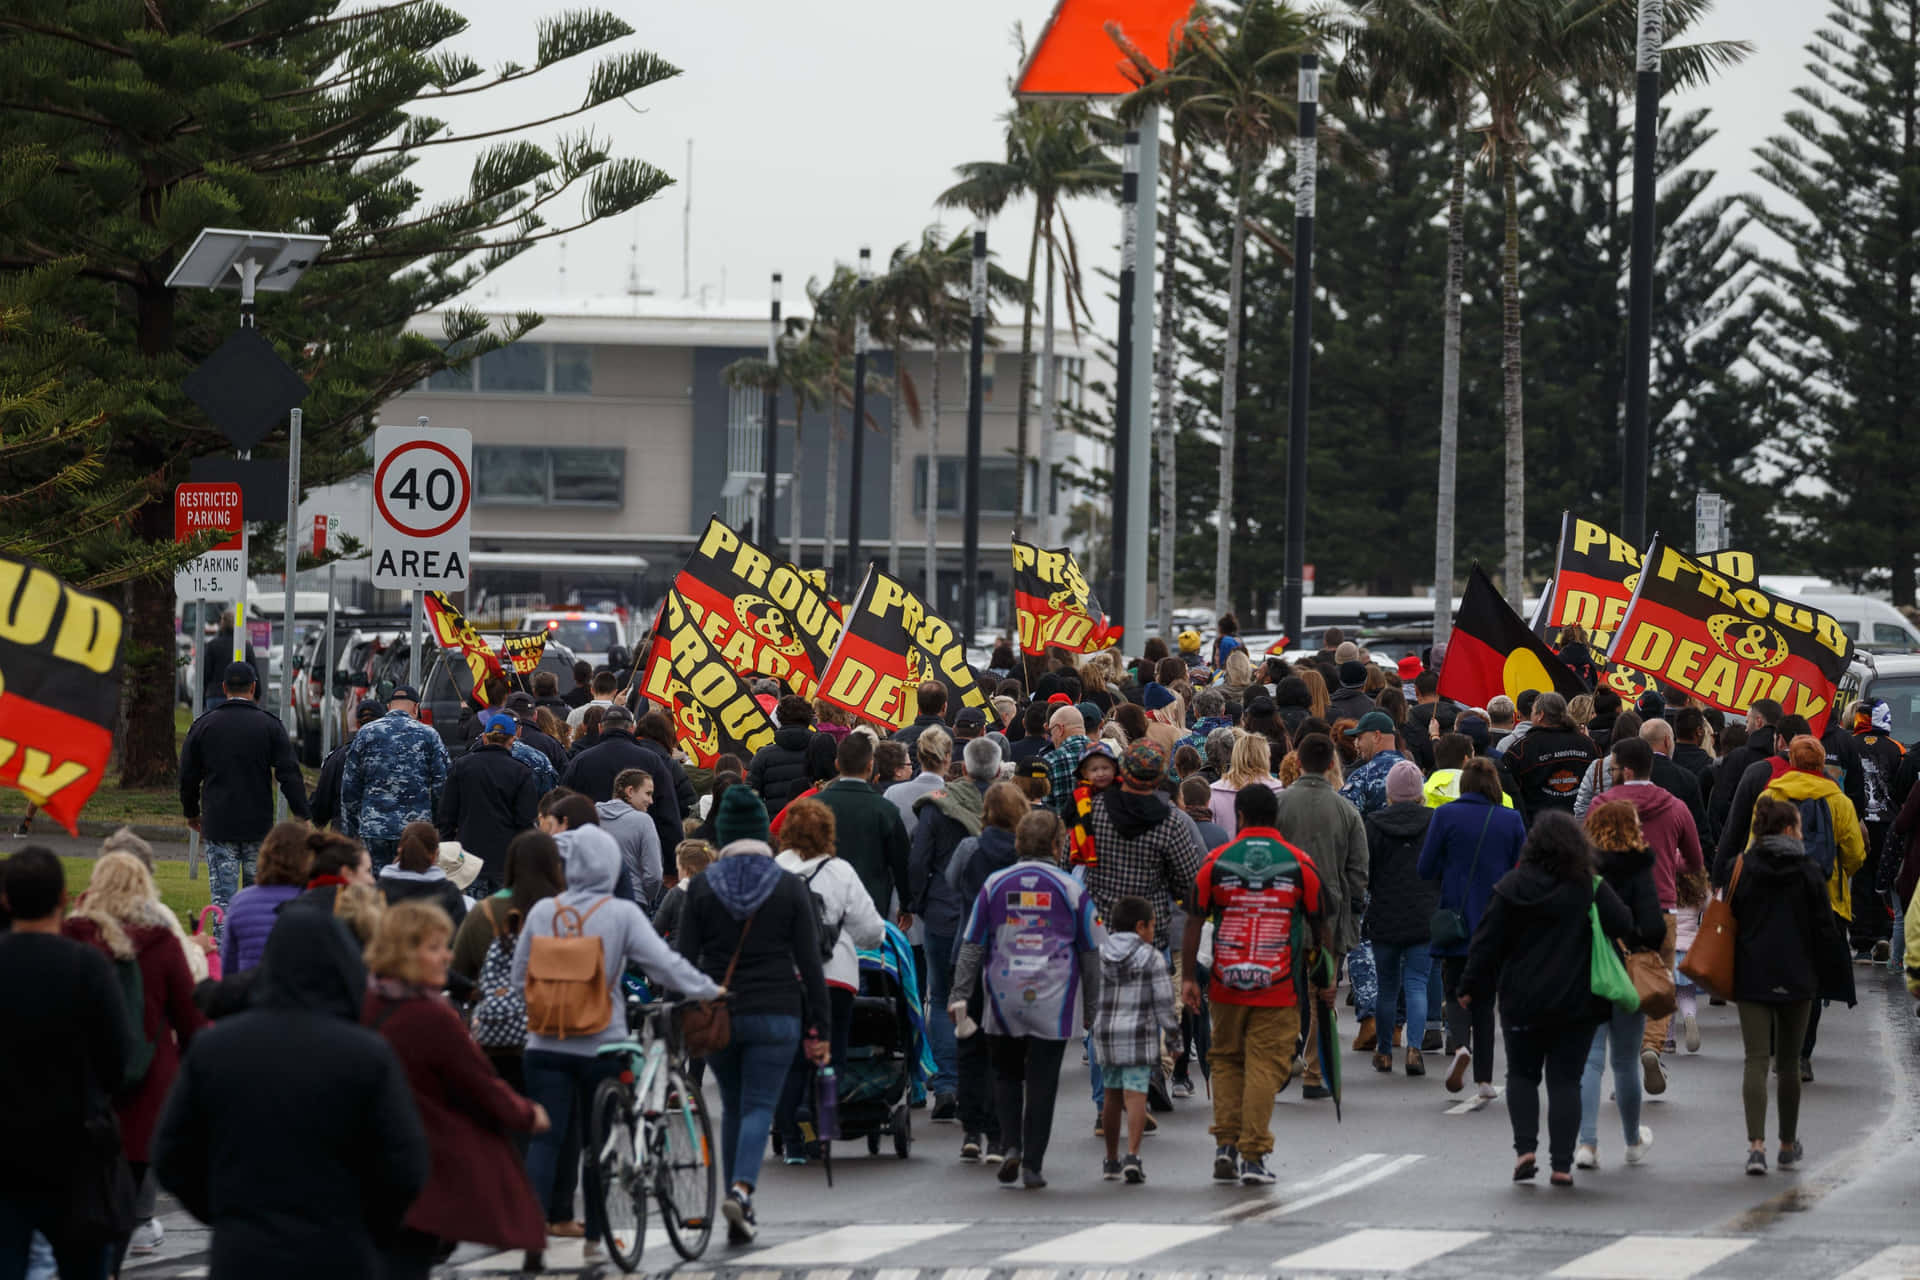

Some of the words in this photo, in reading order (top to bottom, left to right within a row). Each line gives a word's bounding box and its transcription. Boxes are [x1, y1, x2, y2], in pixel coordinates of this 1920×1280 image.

[180, 492, 238, 507] RESTRICTED
[389, 467, 455, 511] 40
[187, 511, 231, 525] PARKING
[196, 558, 239, 572] PARKING
[376, 549, 465, 579] AREA
[1657, 545, 1848, 658] PROUD
[1734, 624, 1774, 663] &
